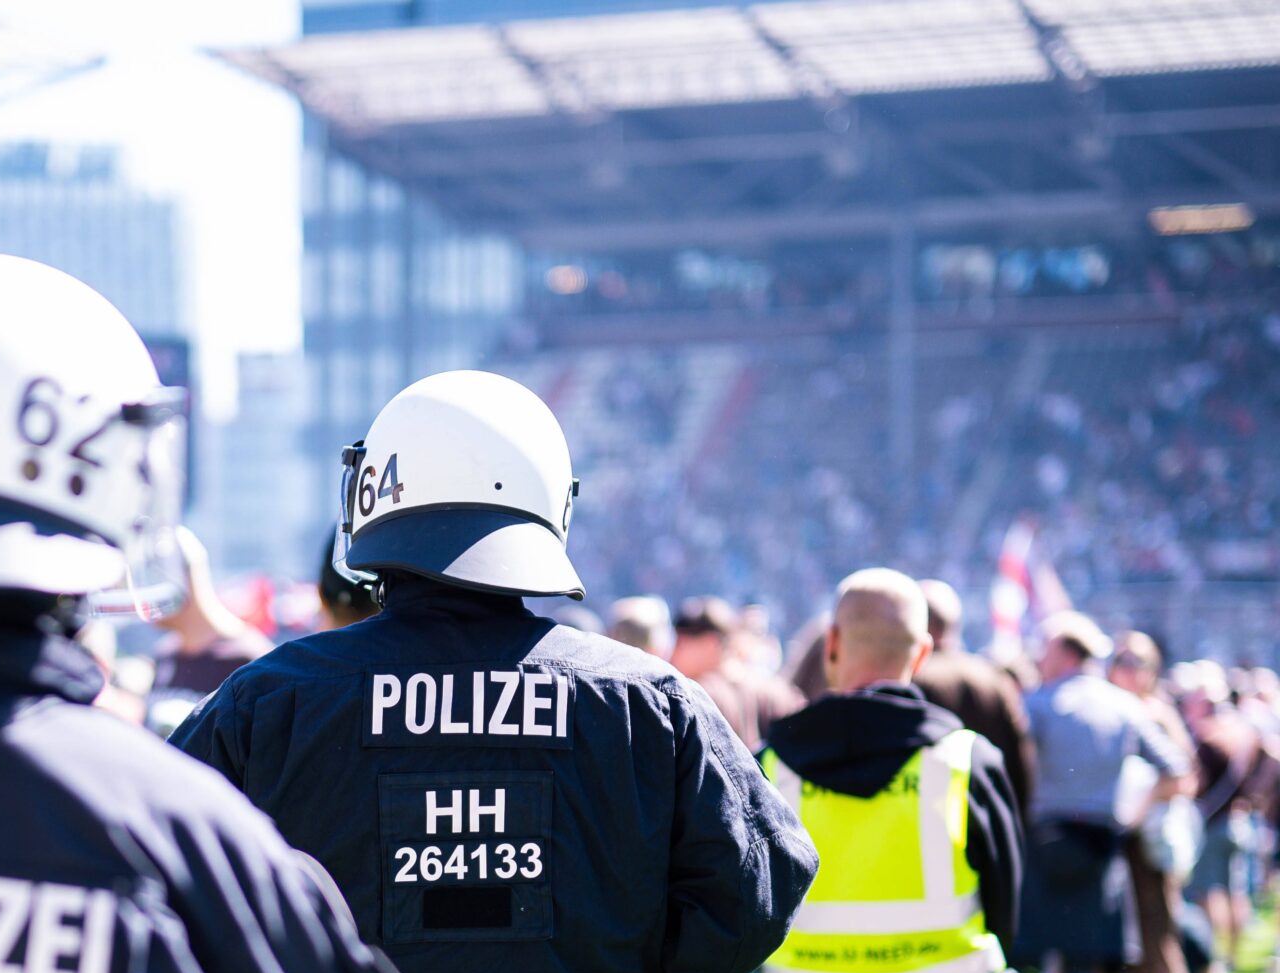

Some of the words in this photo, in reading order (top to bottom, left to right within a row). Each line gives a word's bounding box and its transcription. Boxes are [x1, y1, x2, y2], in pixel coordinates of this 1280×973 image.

[359, 453, 404, 516] 64
[371, 671, 569, 737] POLIZEI
[426, 788, 505, 834] HH
[394, 842, 543, 883] 264133
